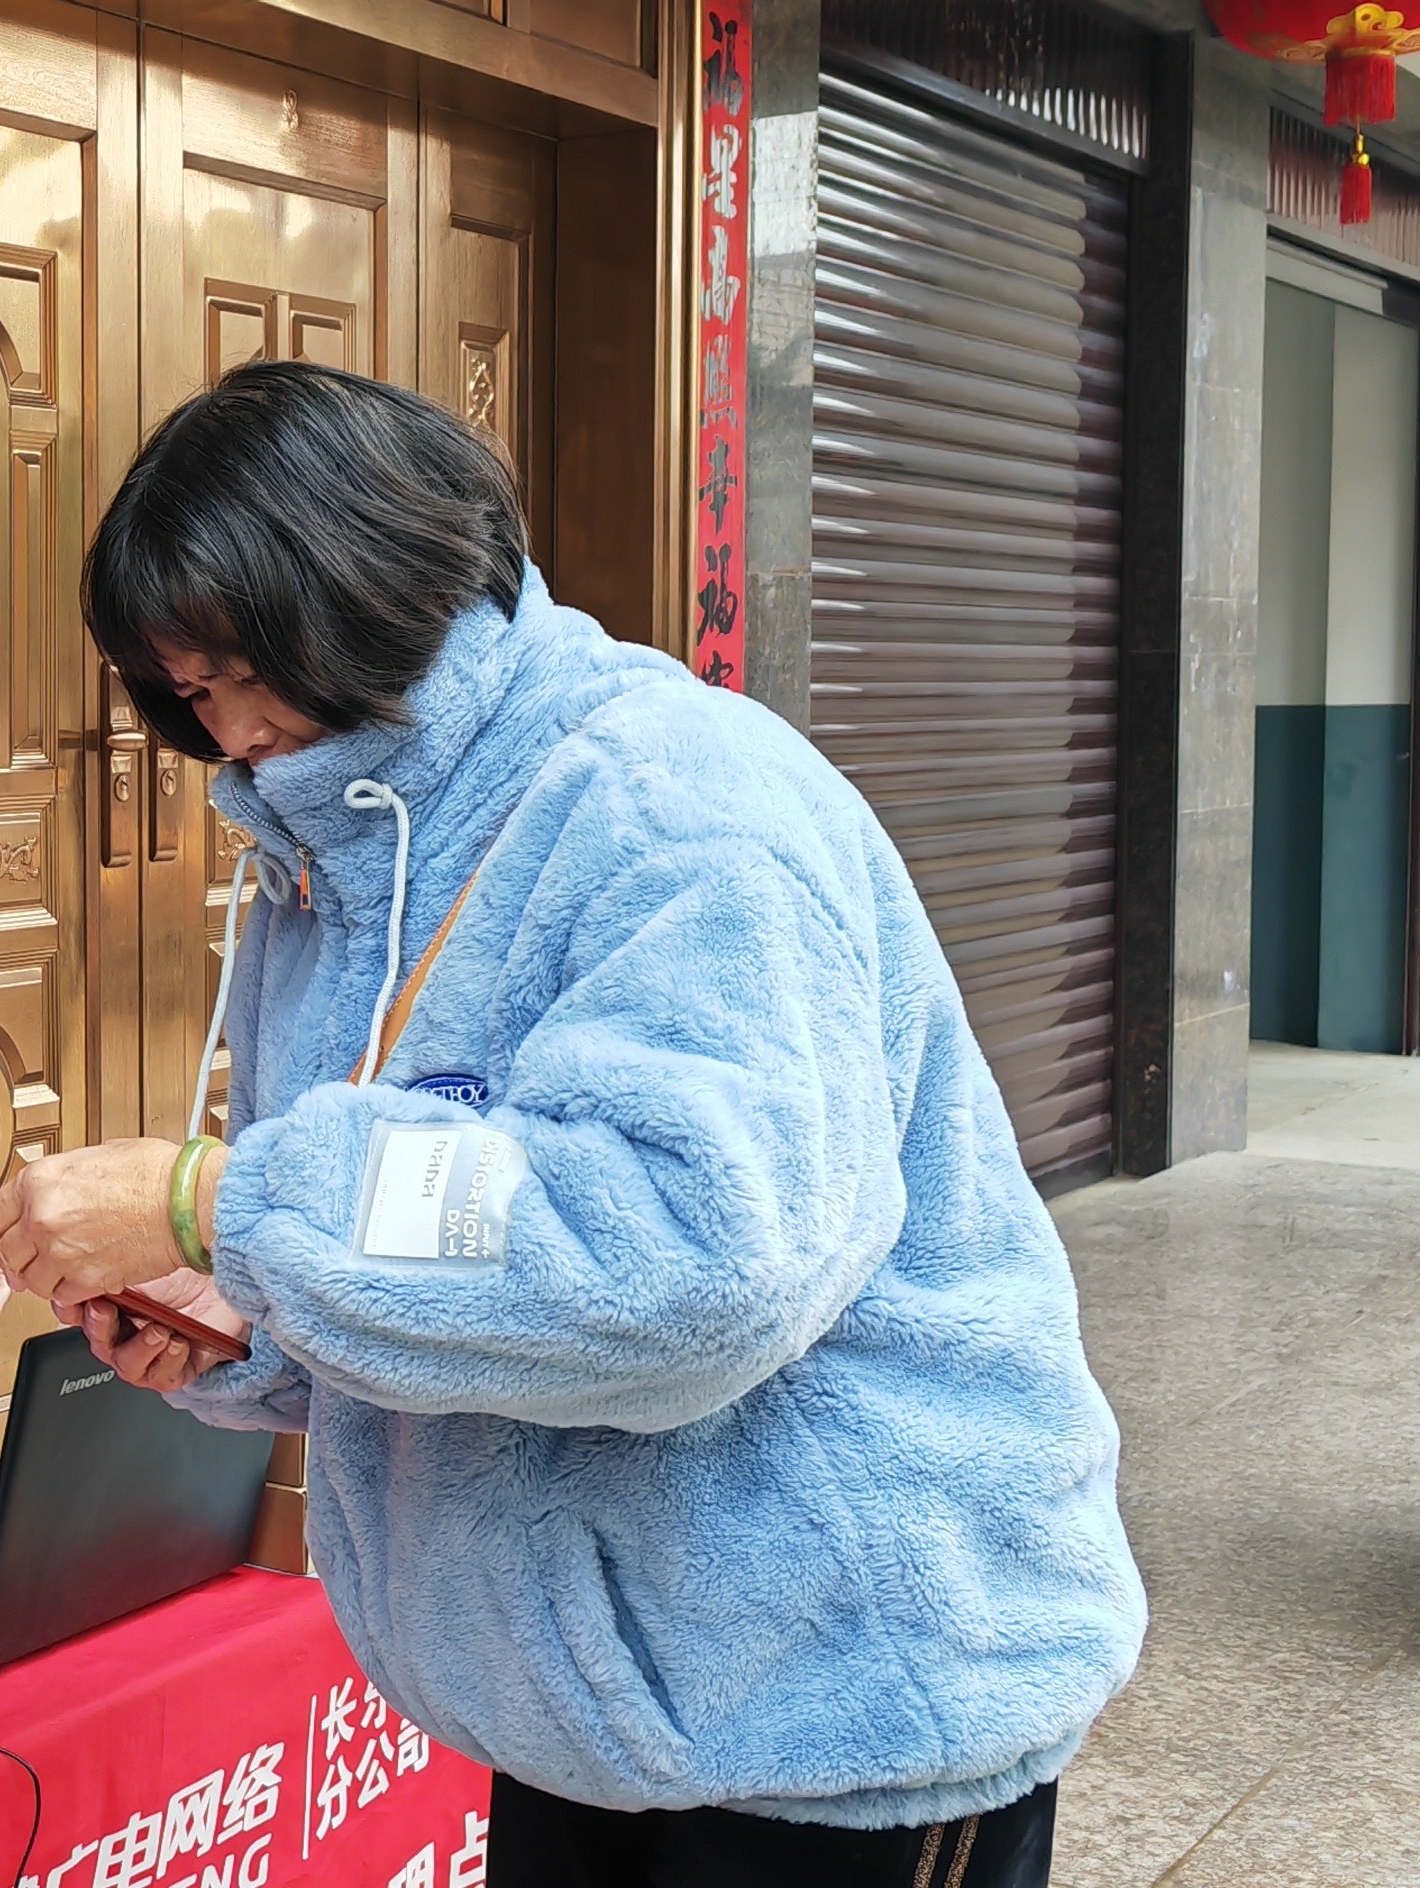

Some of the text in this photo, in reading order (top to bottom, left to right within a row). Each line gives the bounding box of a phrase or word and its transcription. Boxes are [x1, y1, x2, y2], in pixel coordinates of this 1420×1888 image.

[462, 1137, 499, 1258] DISTORTION
[59, 1369, 116, 1397] lenovo
[16, 1741, 285, 1888] 广电网络
[315, 1717, 430, 1841] 分公司
